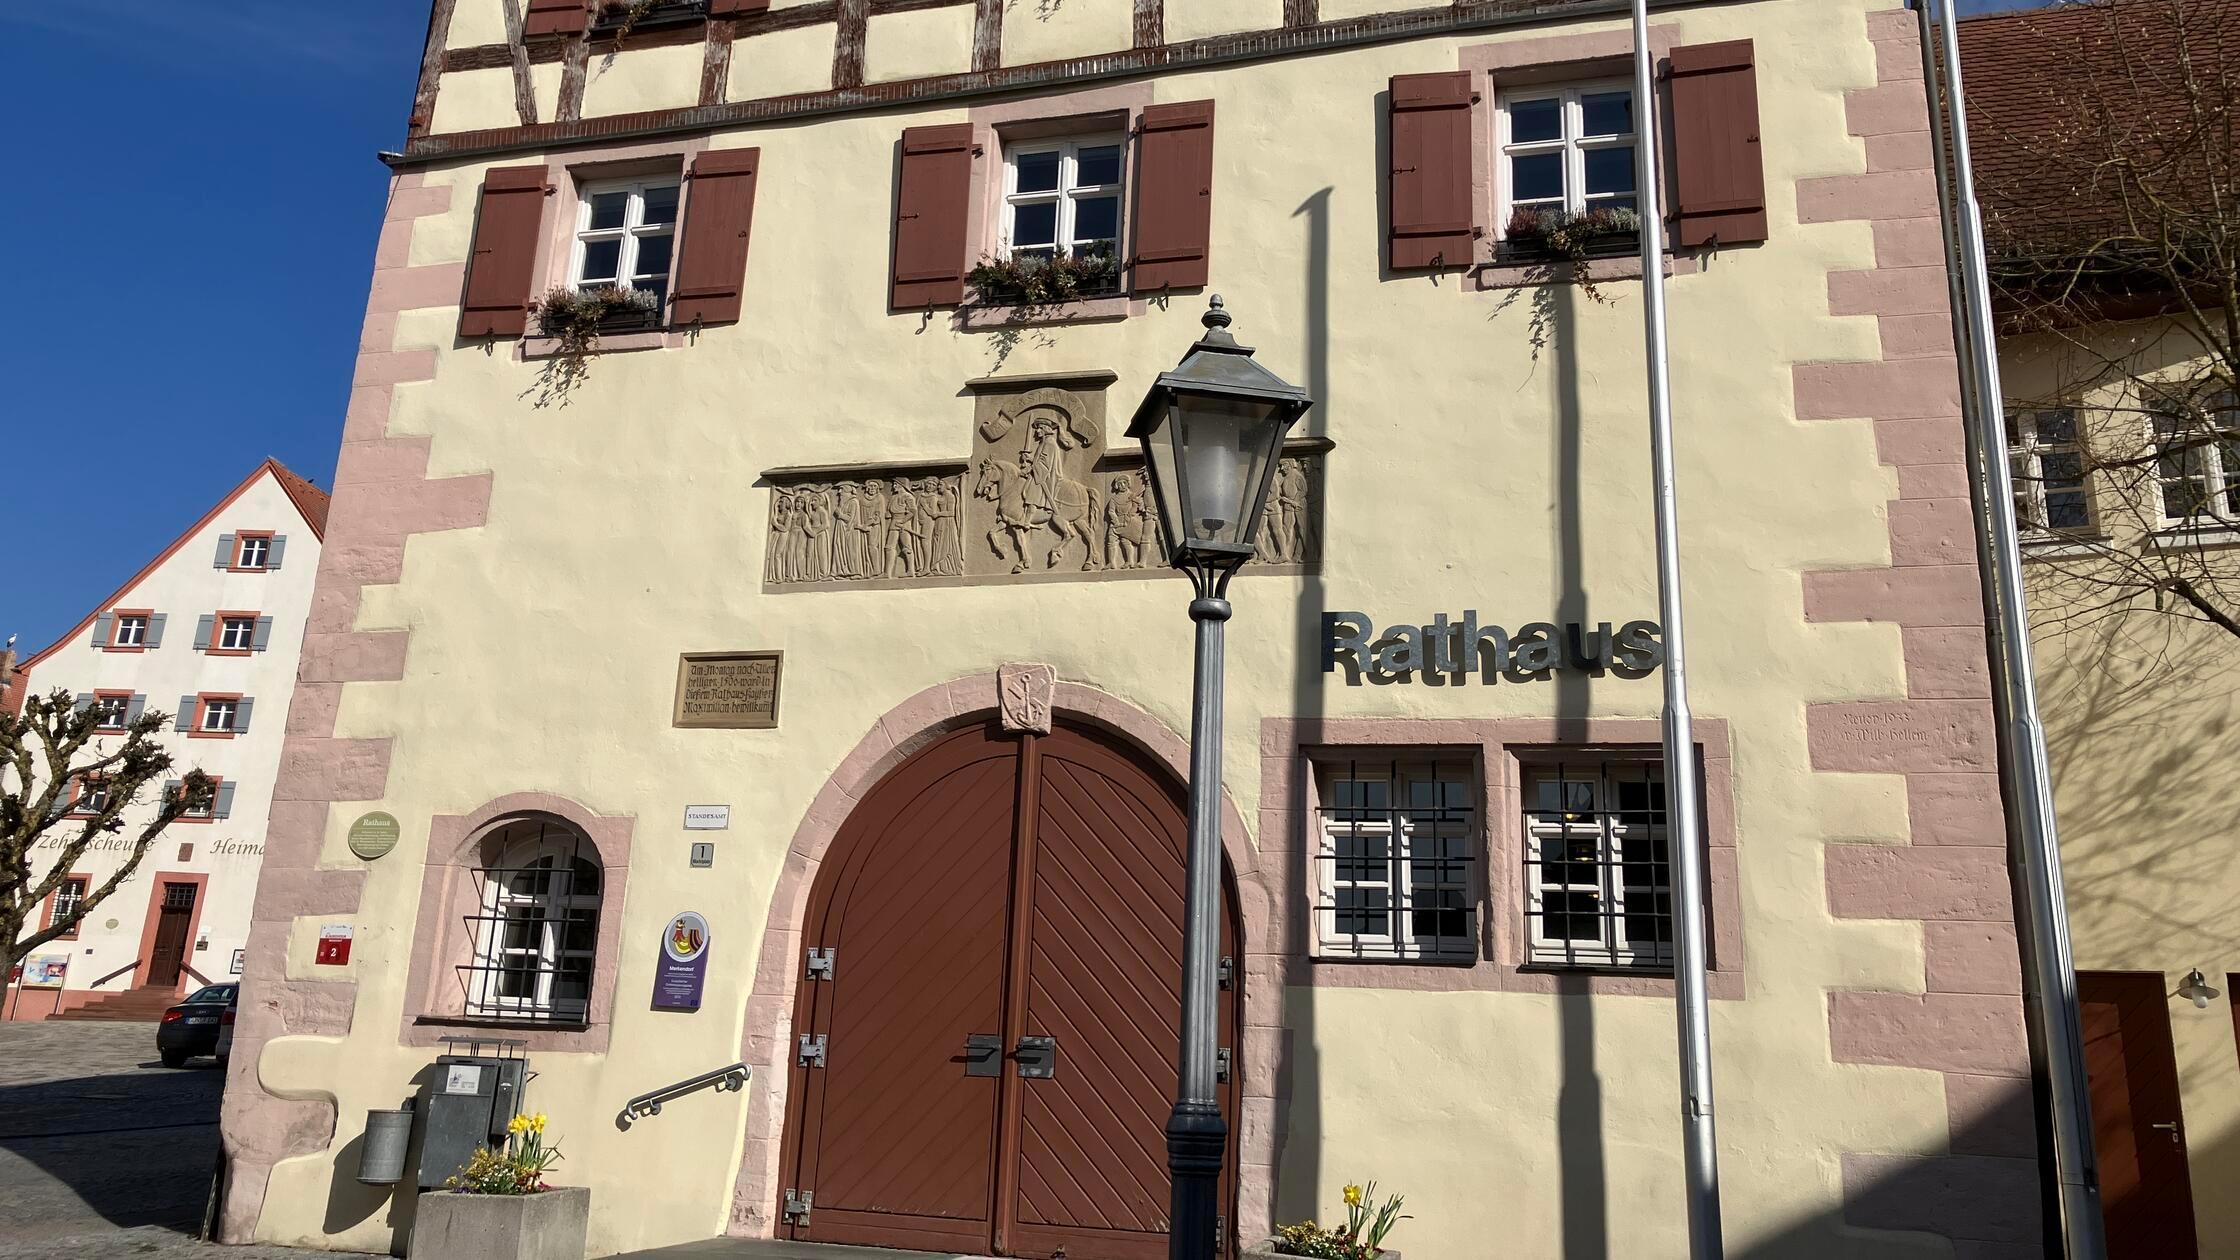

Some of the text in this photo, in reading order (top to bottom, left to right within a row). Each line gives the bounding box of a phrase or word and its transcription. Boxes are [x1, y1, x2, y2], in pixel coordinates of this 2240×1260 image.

[1320, 610, 1664, 673] Rathaus
[37, 833, 154, 852] Zehscheue
[700, 846, 705, 858] 1
[331, 948, 336, 957] 2
